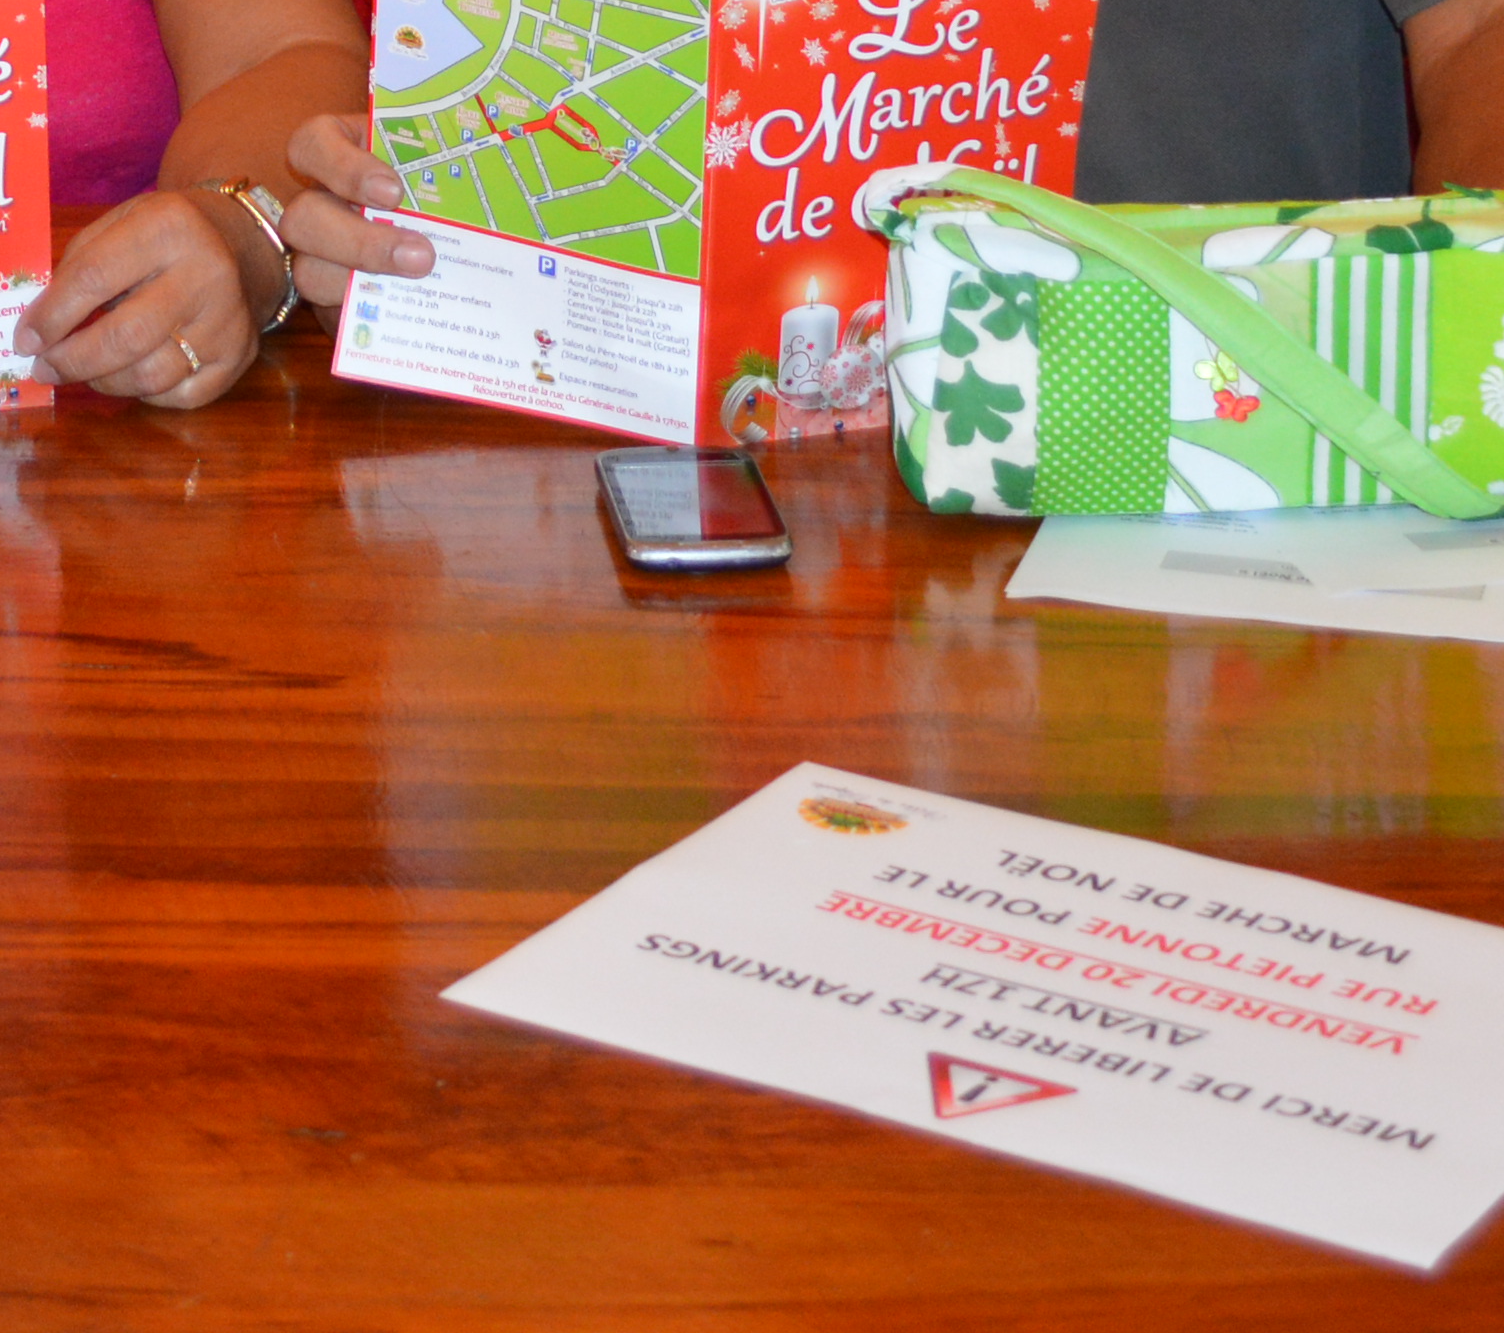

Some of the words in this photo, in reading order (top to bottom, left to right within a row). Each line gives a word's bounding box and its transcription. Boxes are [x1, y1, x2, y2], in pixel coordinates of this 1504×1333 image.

[748, 47, 1051, 169] Marché
[755, 167, 835, 244] de
[871, 860, 930, 891] LE
[931, 879, 1073, 929] POUR
[993, 845, 1115, 900] NOËL
[1120, 879, 1189, 914] DE
[817, 890, 1073, 982] DECEMBRE
[1078, 912, 1325, 994] PIETONNE
[1196, 897, 1411, 968] MARCHE
[634, 929, 872, 1021] PARKINGS
[921, 961, 1015, 1005] 17H
[1078, 960, 1144, 998] 20
[1329, 974, 1441, 1019] RUE
[878, 996, 971, 1046] LES
[1016, 988, 1199, 1053] AVANT
[1148, 977, 1411, 1060] VENDREDI
[975, 1025, 1175, 1088] LIBERER
[1181, 1070, 1251, 1108] DE
[1256, 1088, 1438, 1156] MERCI
